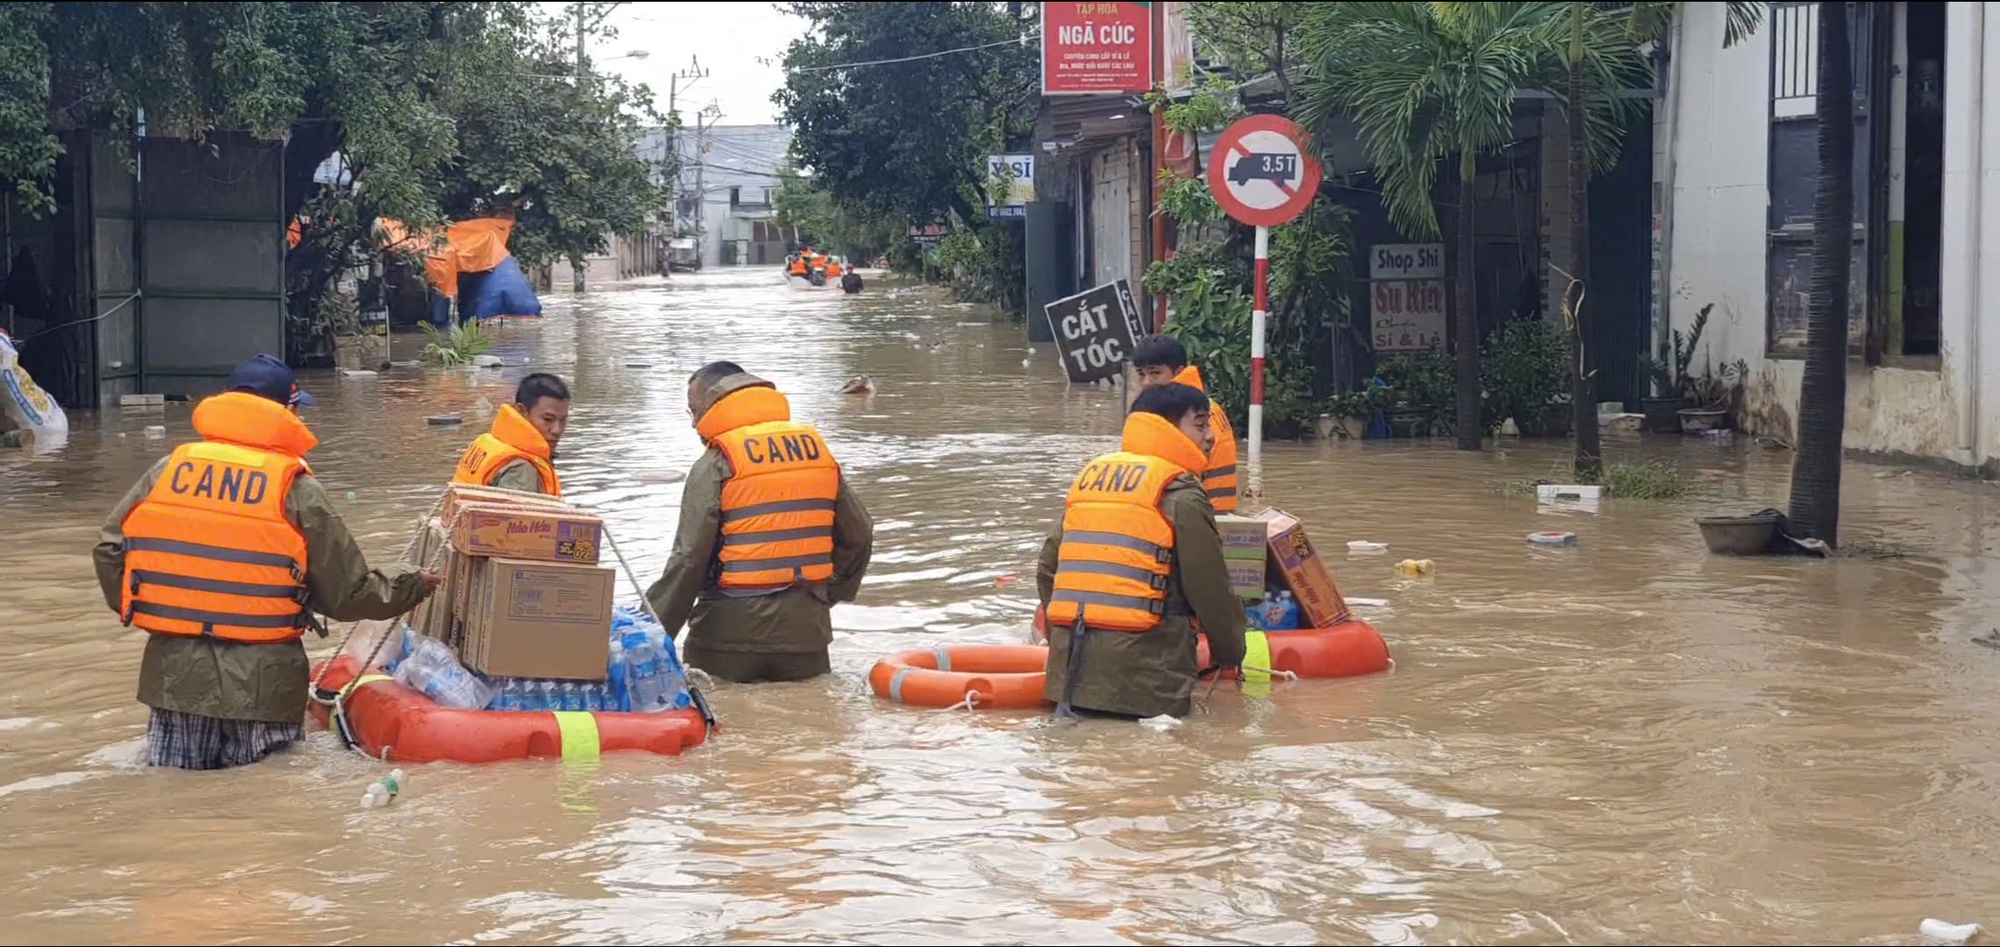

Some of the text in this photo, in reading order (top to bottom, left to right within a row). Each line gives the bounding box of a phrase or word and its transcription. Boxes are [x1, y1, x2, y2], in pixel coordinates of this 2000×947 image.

[1059, 20, 1135, 45] NGÃ CÚC
[1378, 248, 1439, 274] Shop Shi
[1061, 299, 1109, 340] CẮT
[1070, 336, 1123, 372] TÓC
[1400, 333, 1413, 346] &
[743, 434, 820, 464] CAND
[171, 462, 268, 505] CAND
[1078, 463, 1148, 492] CAND
